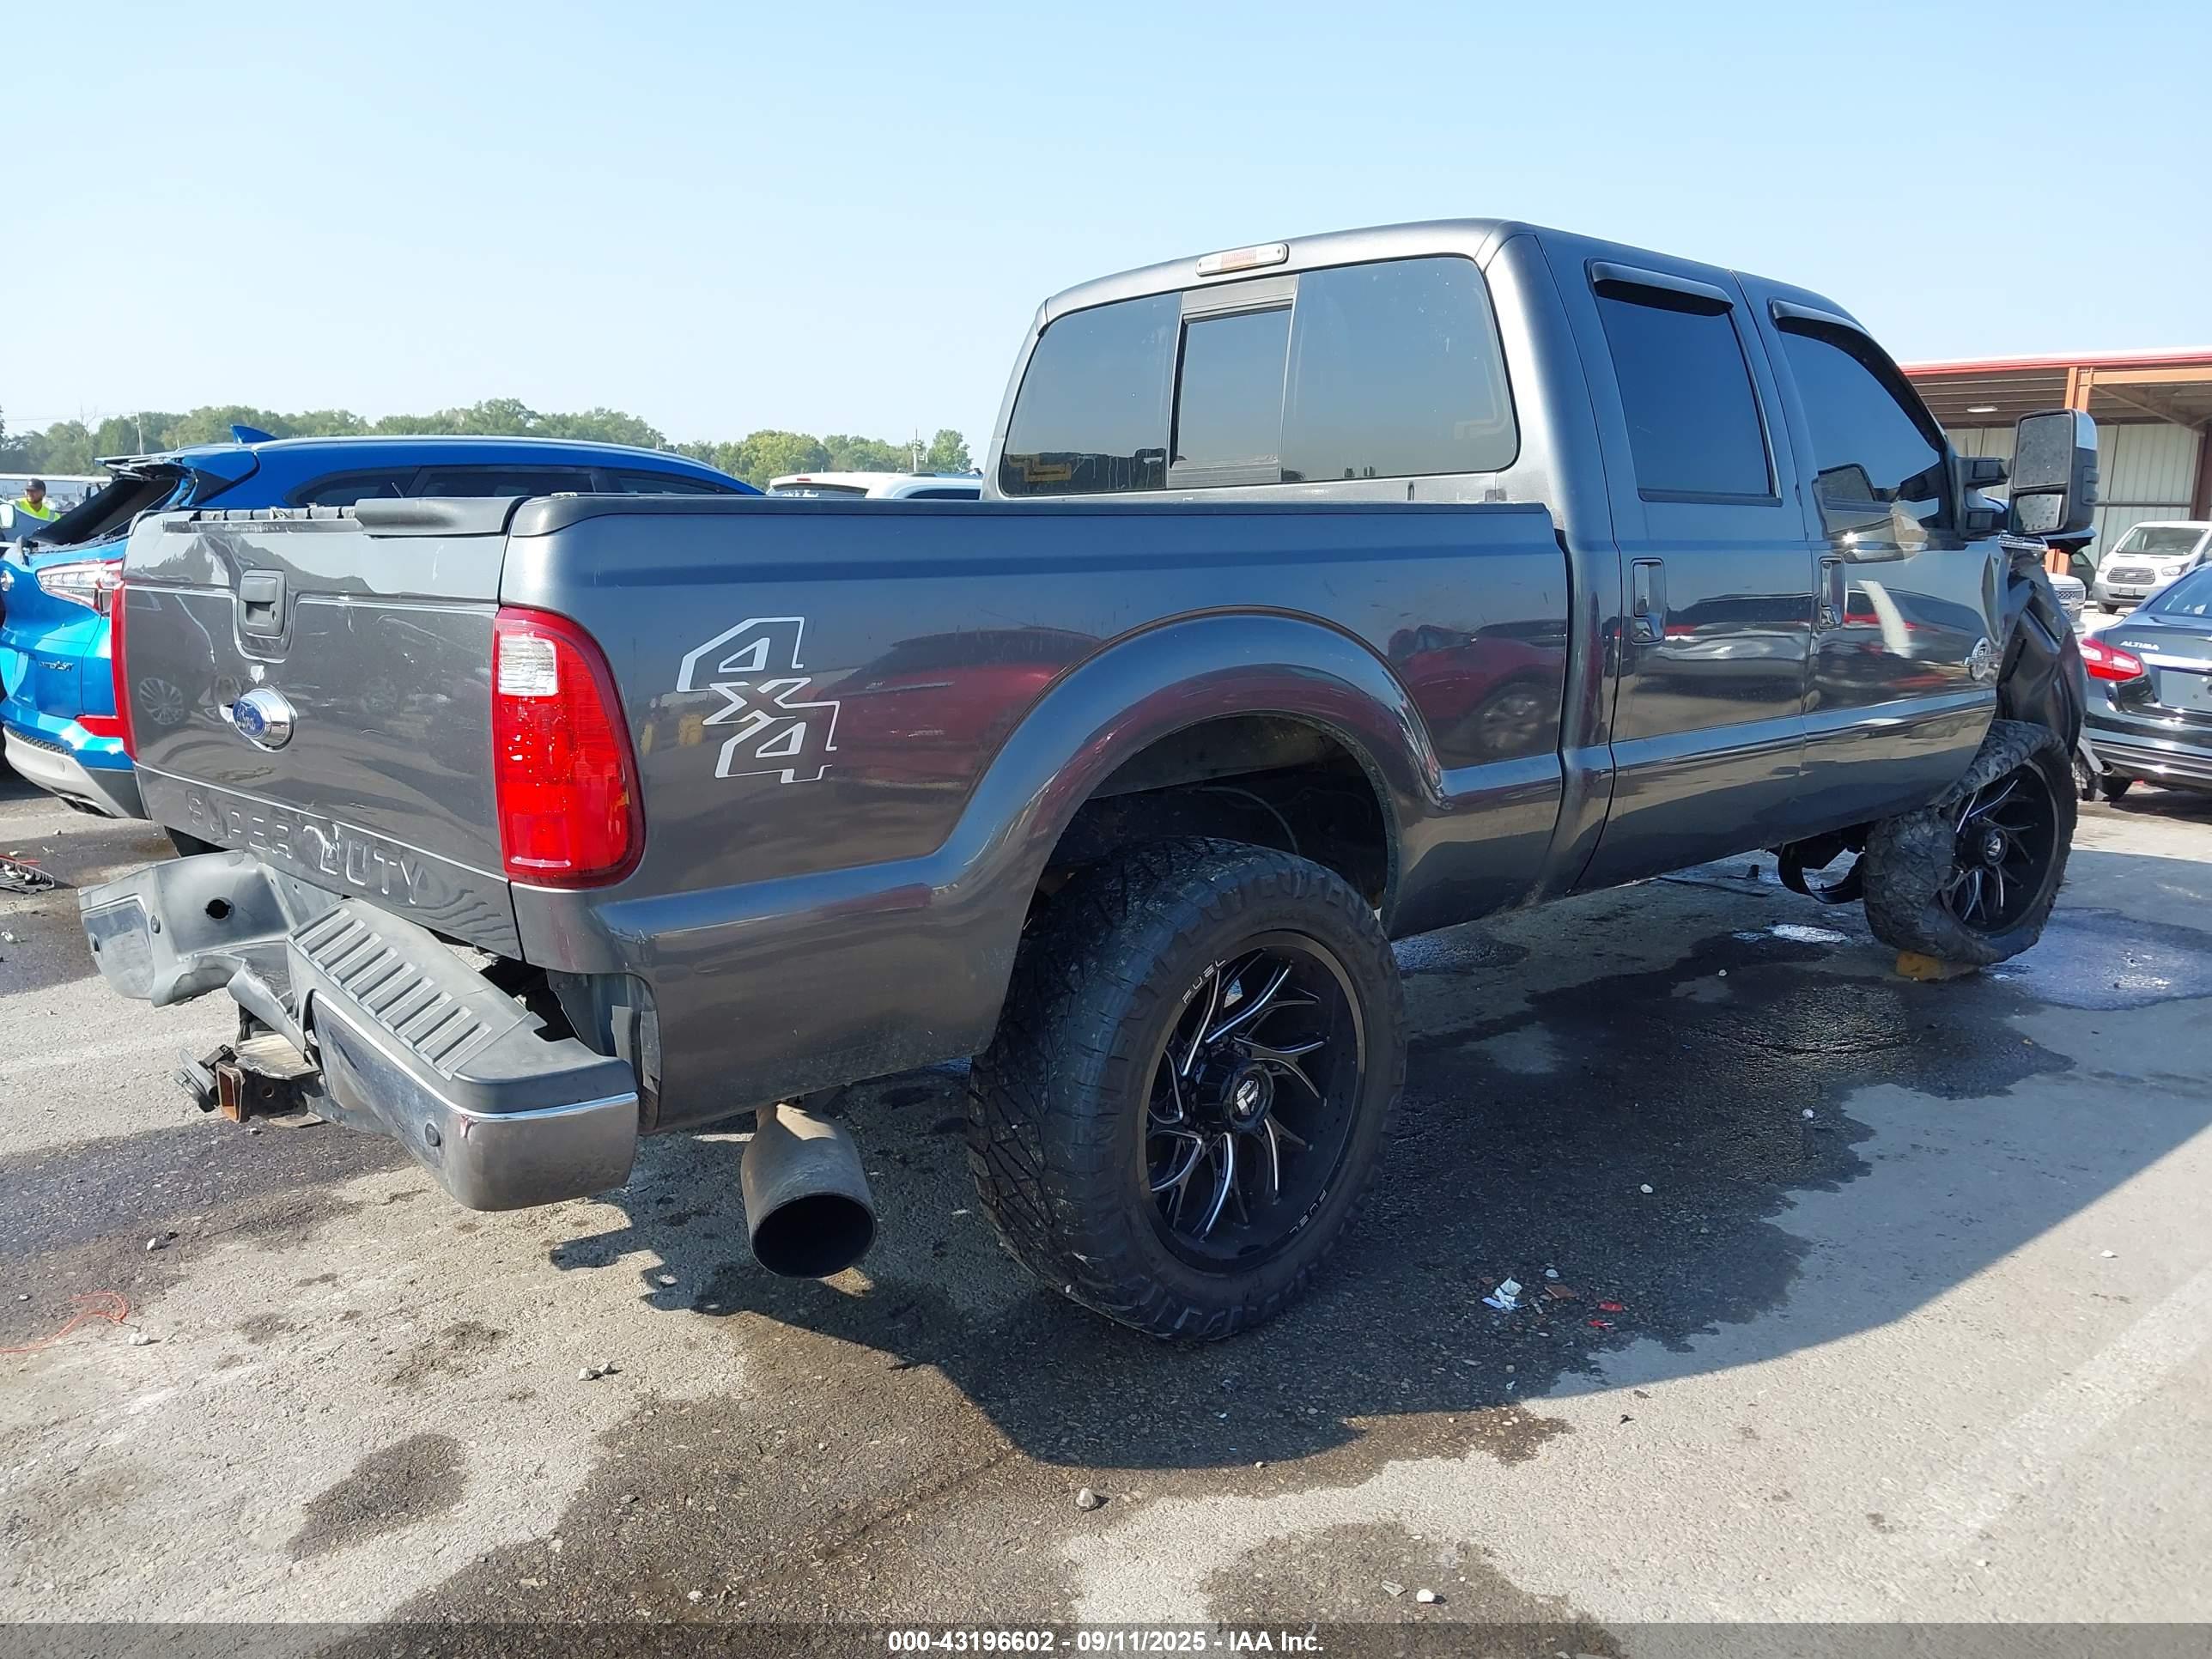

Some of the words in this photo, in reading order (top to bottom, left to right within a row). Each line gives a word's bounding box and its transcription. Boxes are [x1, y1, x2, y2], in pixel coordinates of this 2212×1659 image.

[2120, 641, 2160, 652] ALTIMA
[1182, 959, 1226, 1004] FUEL
[1288, 1188, 1327, 1234] FUEL
